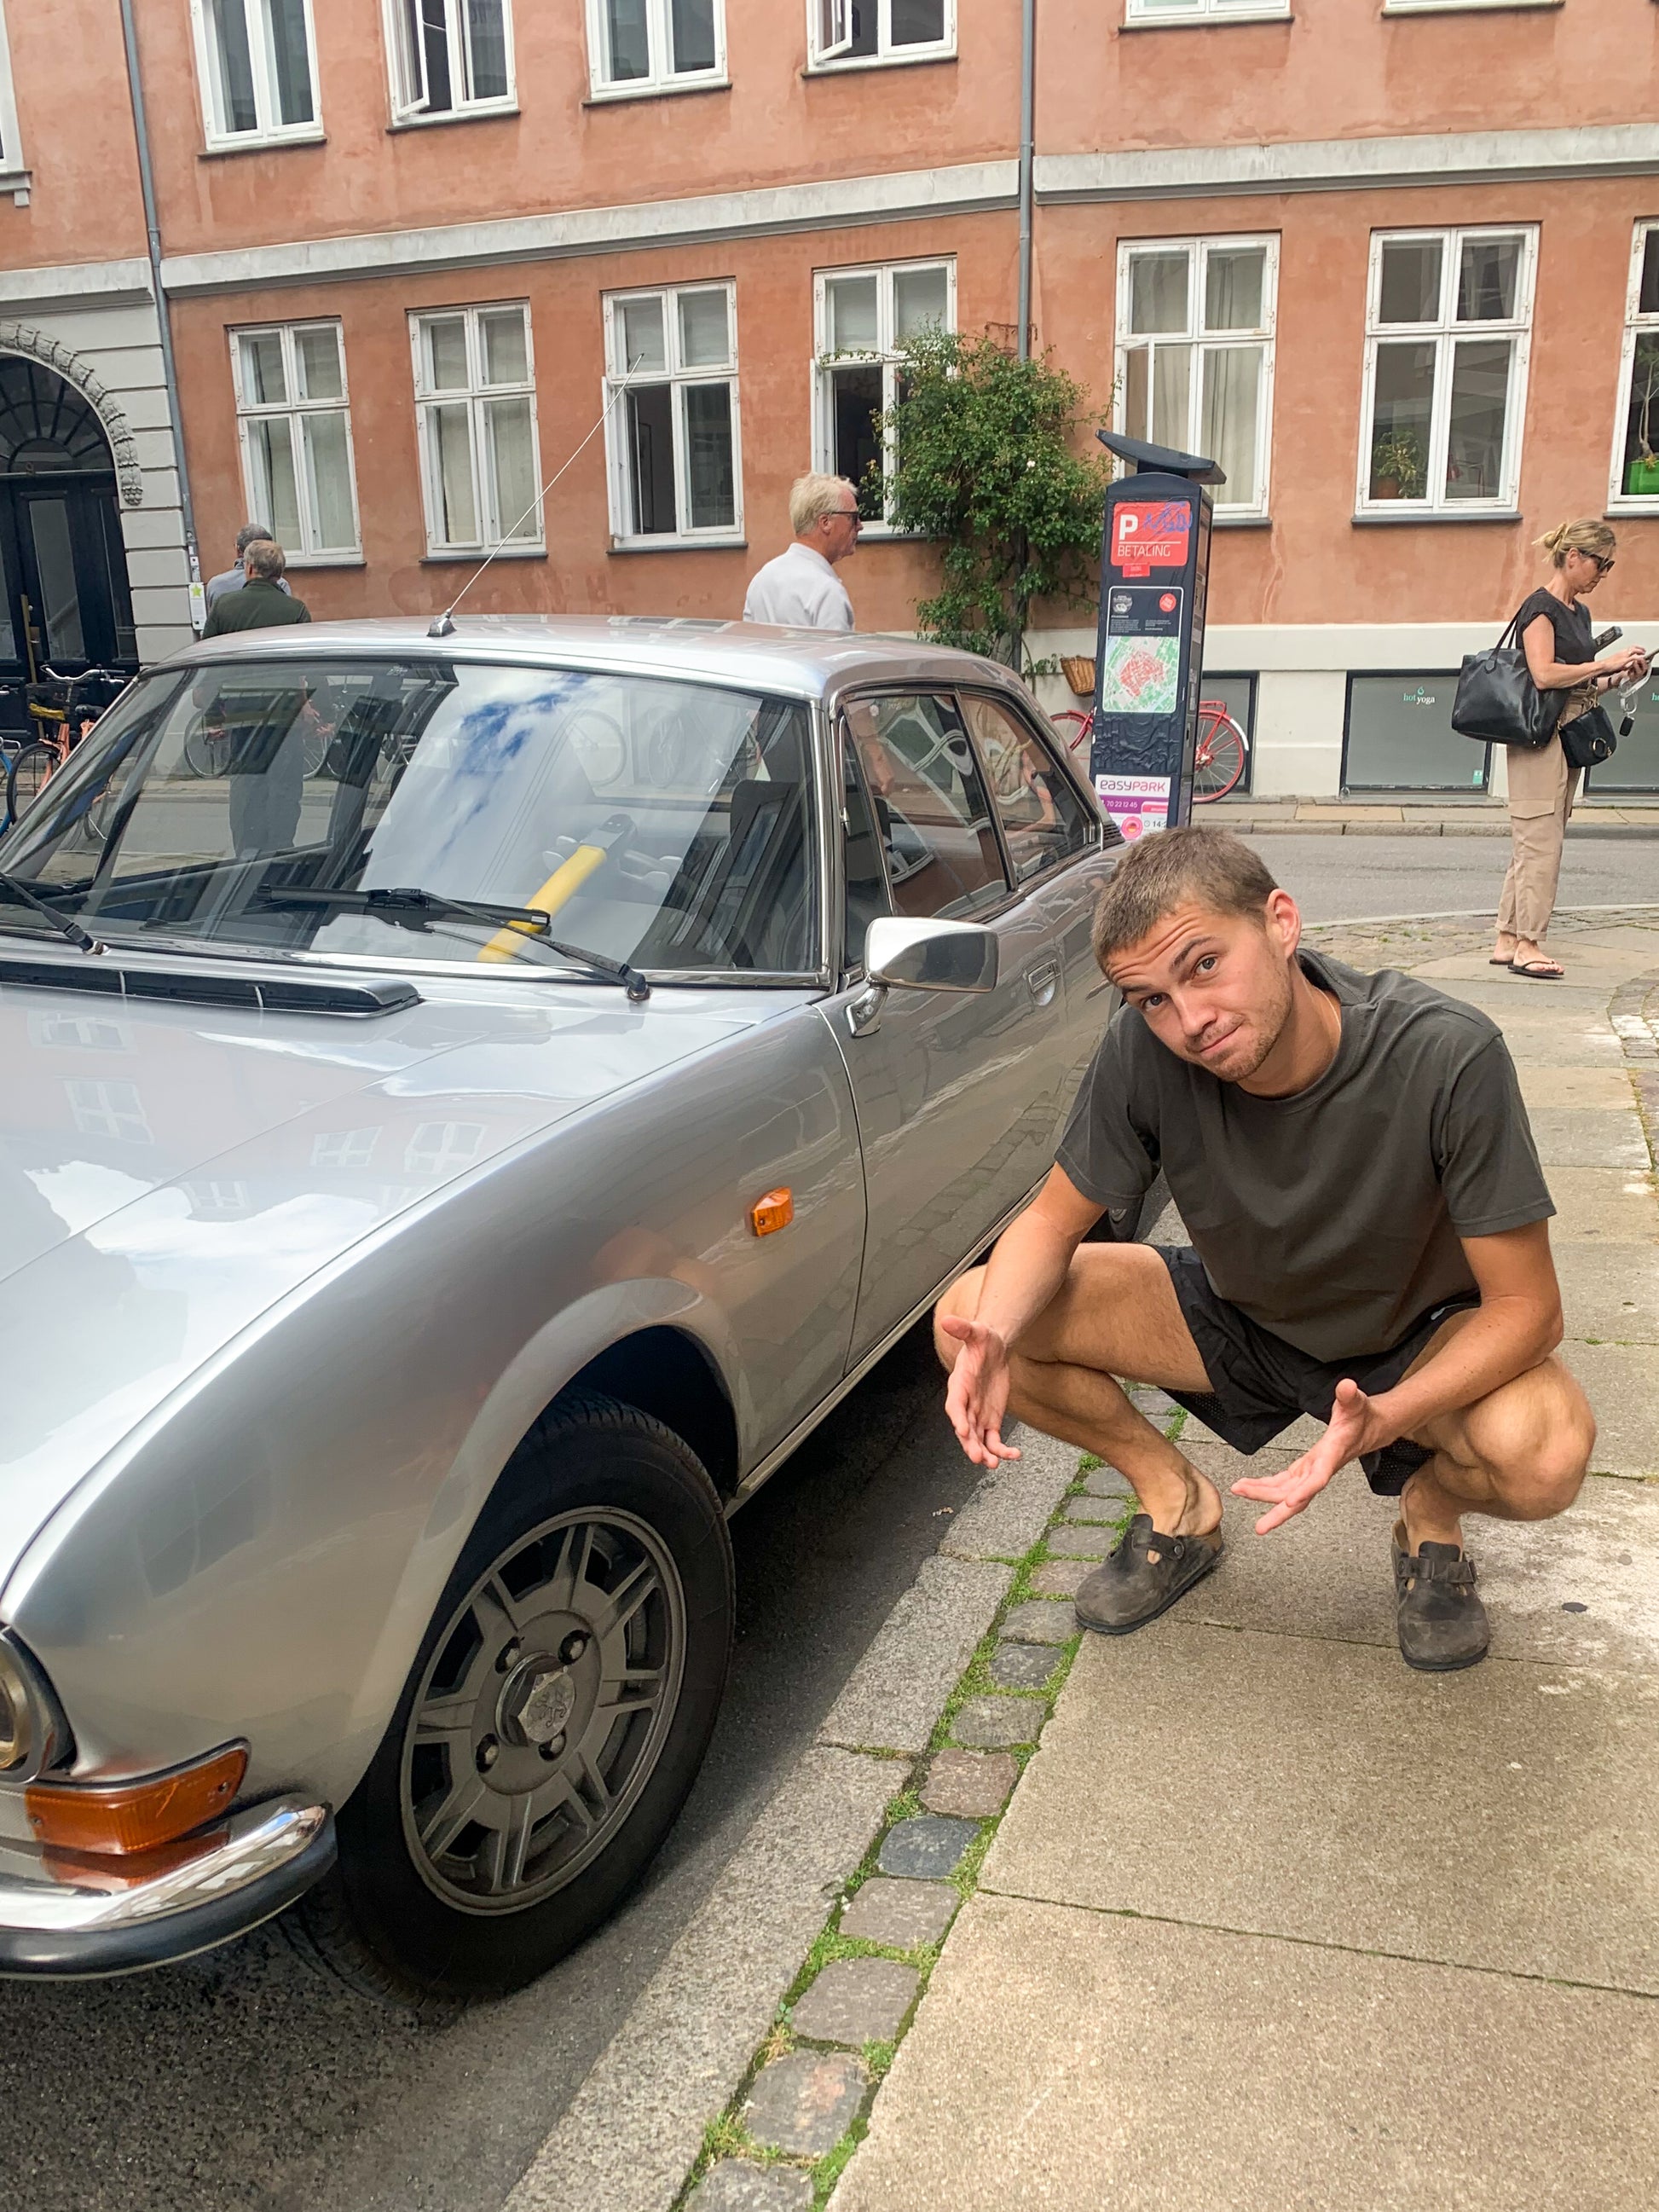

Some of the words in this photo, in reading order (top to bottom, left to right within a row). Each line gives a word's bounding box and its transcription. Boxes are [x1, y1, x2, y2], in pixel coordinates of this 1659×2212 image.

[1119, 514, 1138, 541] P
[1118, 545, 1171, 557] BETALING
[1403, 692, 1416, 701] hot
[1416, 696, 1436, 705] yoga
